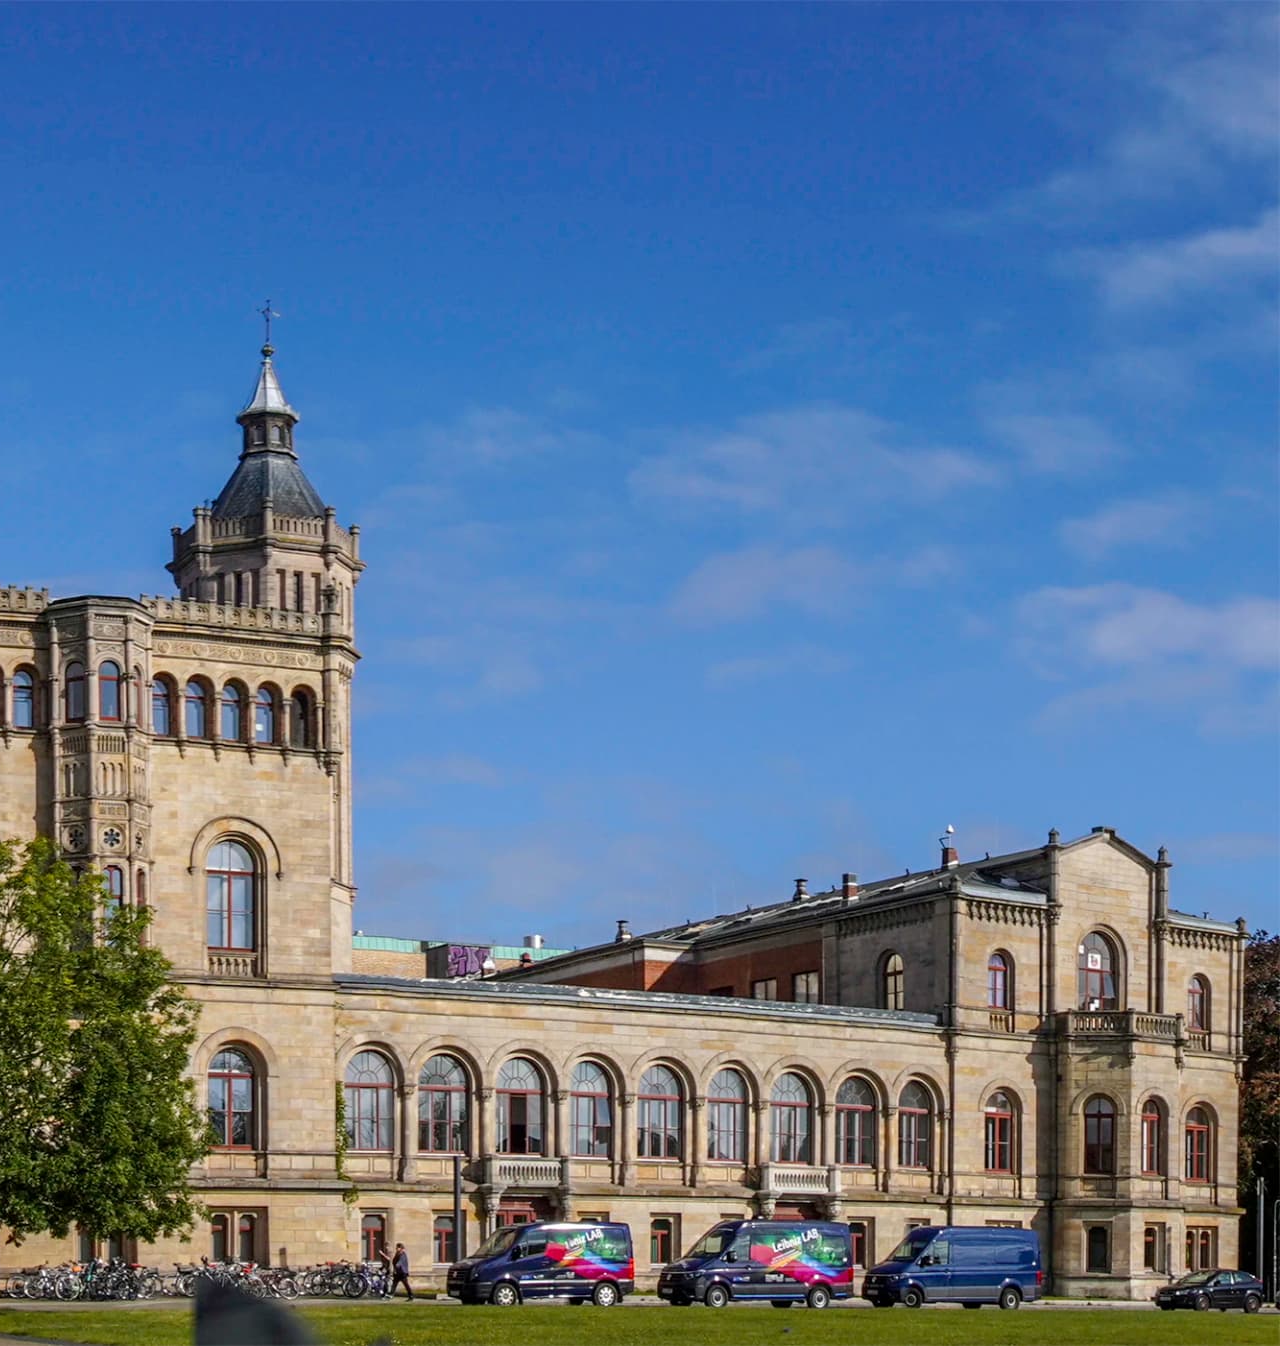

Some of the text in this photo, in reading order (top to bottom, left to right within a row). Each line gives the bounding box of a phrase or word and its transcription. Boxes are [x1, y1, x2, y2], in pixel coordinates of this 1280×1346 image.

[585, 1228, 604, 1242] LAB
[772, 1228, 820, 1253] Leibniz LAB
